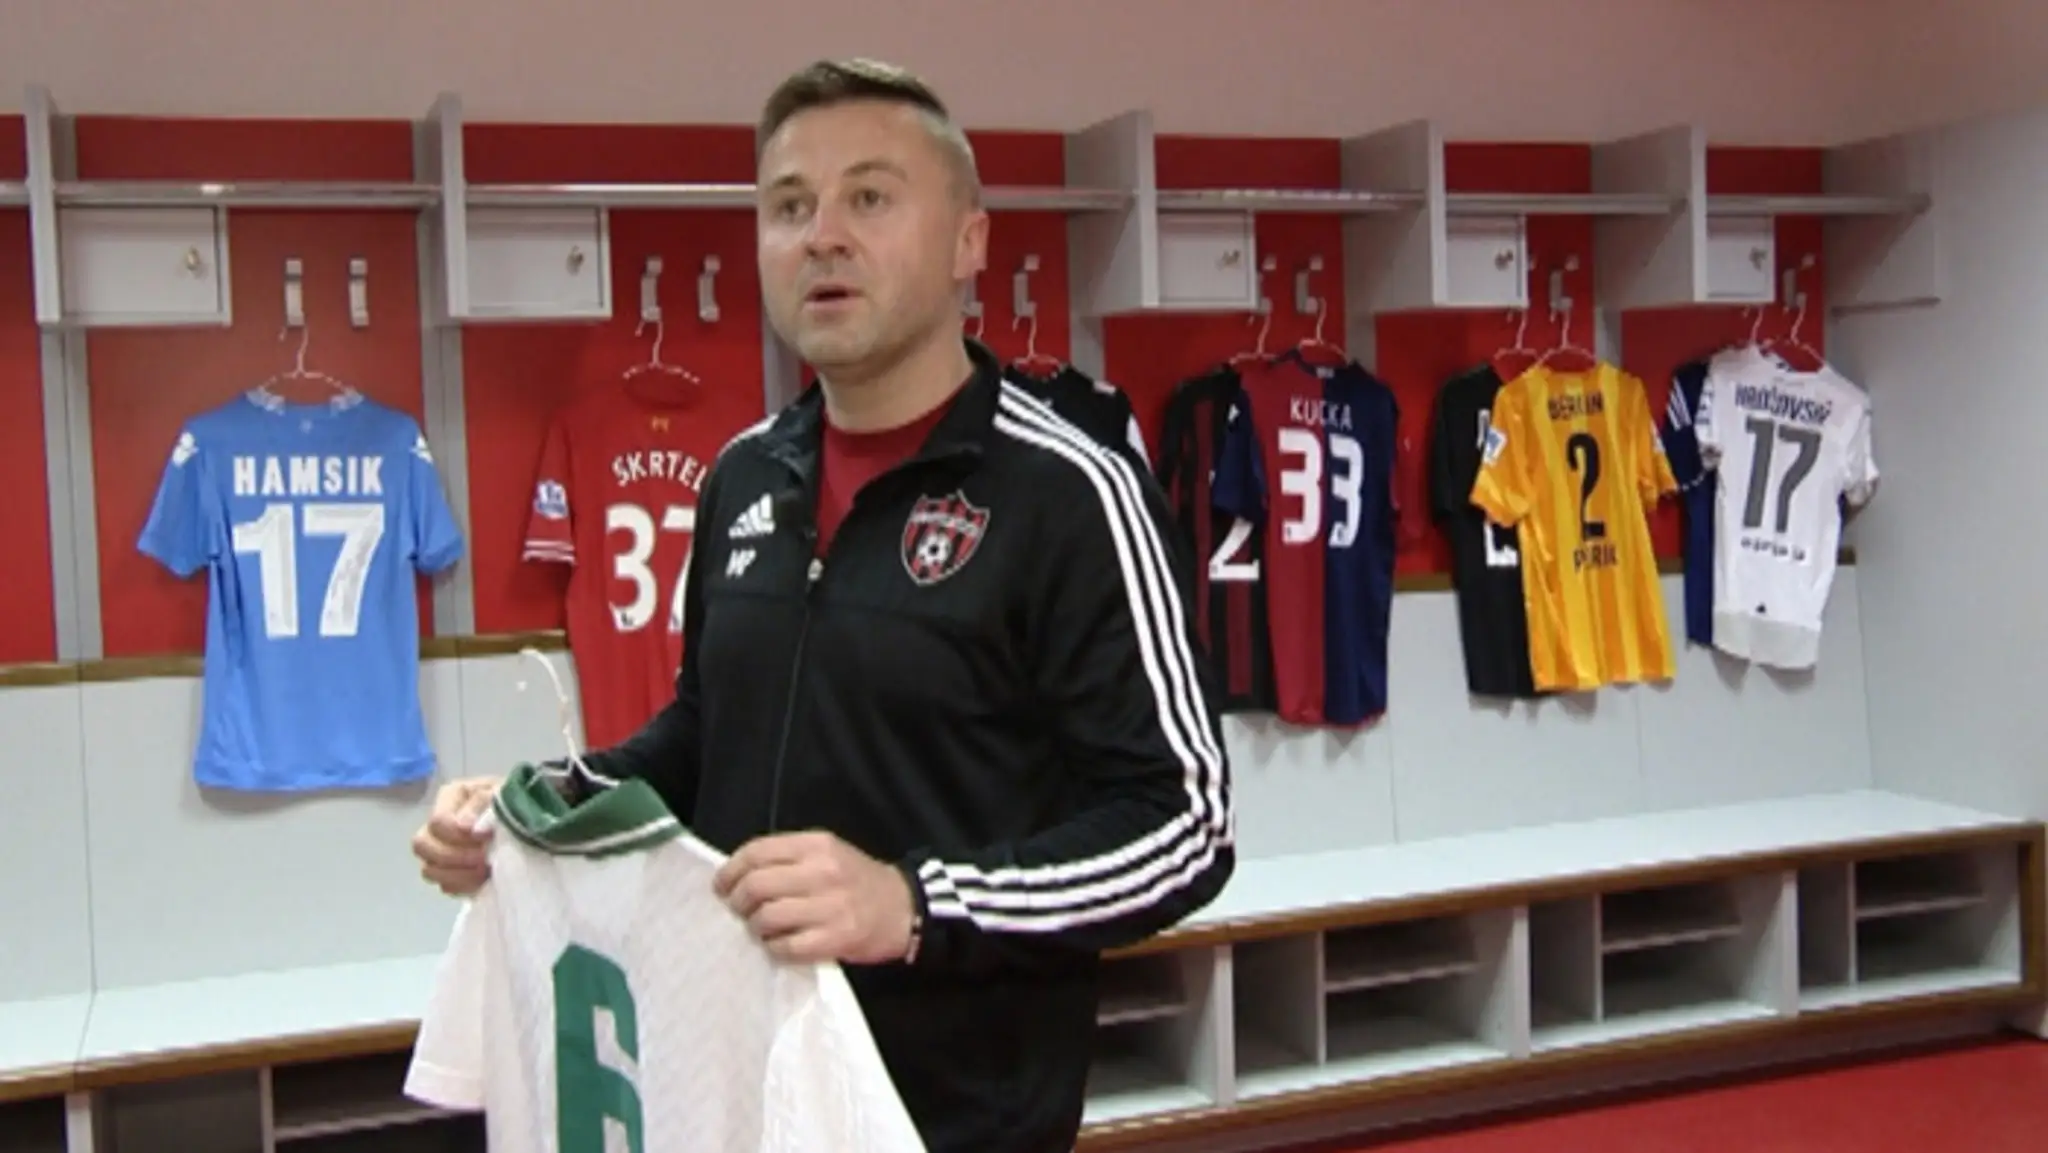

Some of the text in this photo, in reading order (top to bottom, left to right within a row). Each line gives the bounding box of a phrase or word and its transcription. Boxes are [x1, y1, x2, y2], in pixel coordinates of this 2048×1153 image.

[1290, 397, 1353, 430] KUCKA
[233, 456, 384, 496] HAMSIK
[1278, 428, 1365, 548] 33
[1566, 432, 1606, 542] 2
[1743, 414, 1822, 534] 17
[232, 502, 385, 640] 17
[605, 502, 697, 634] 37
[551, 943, 645, 1153] 6
